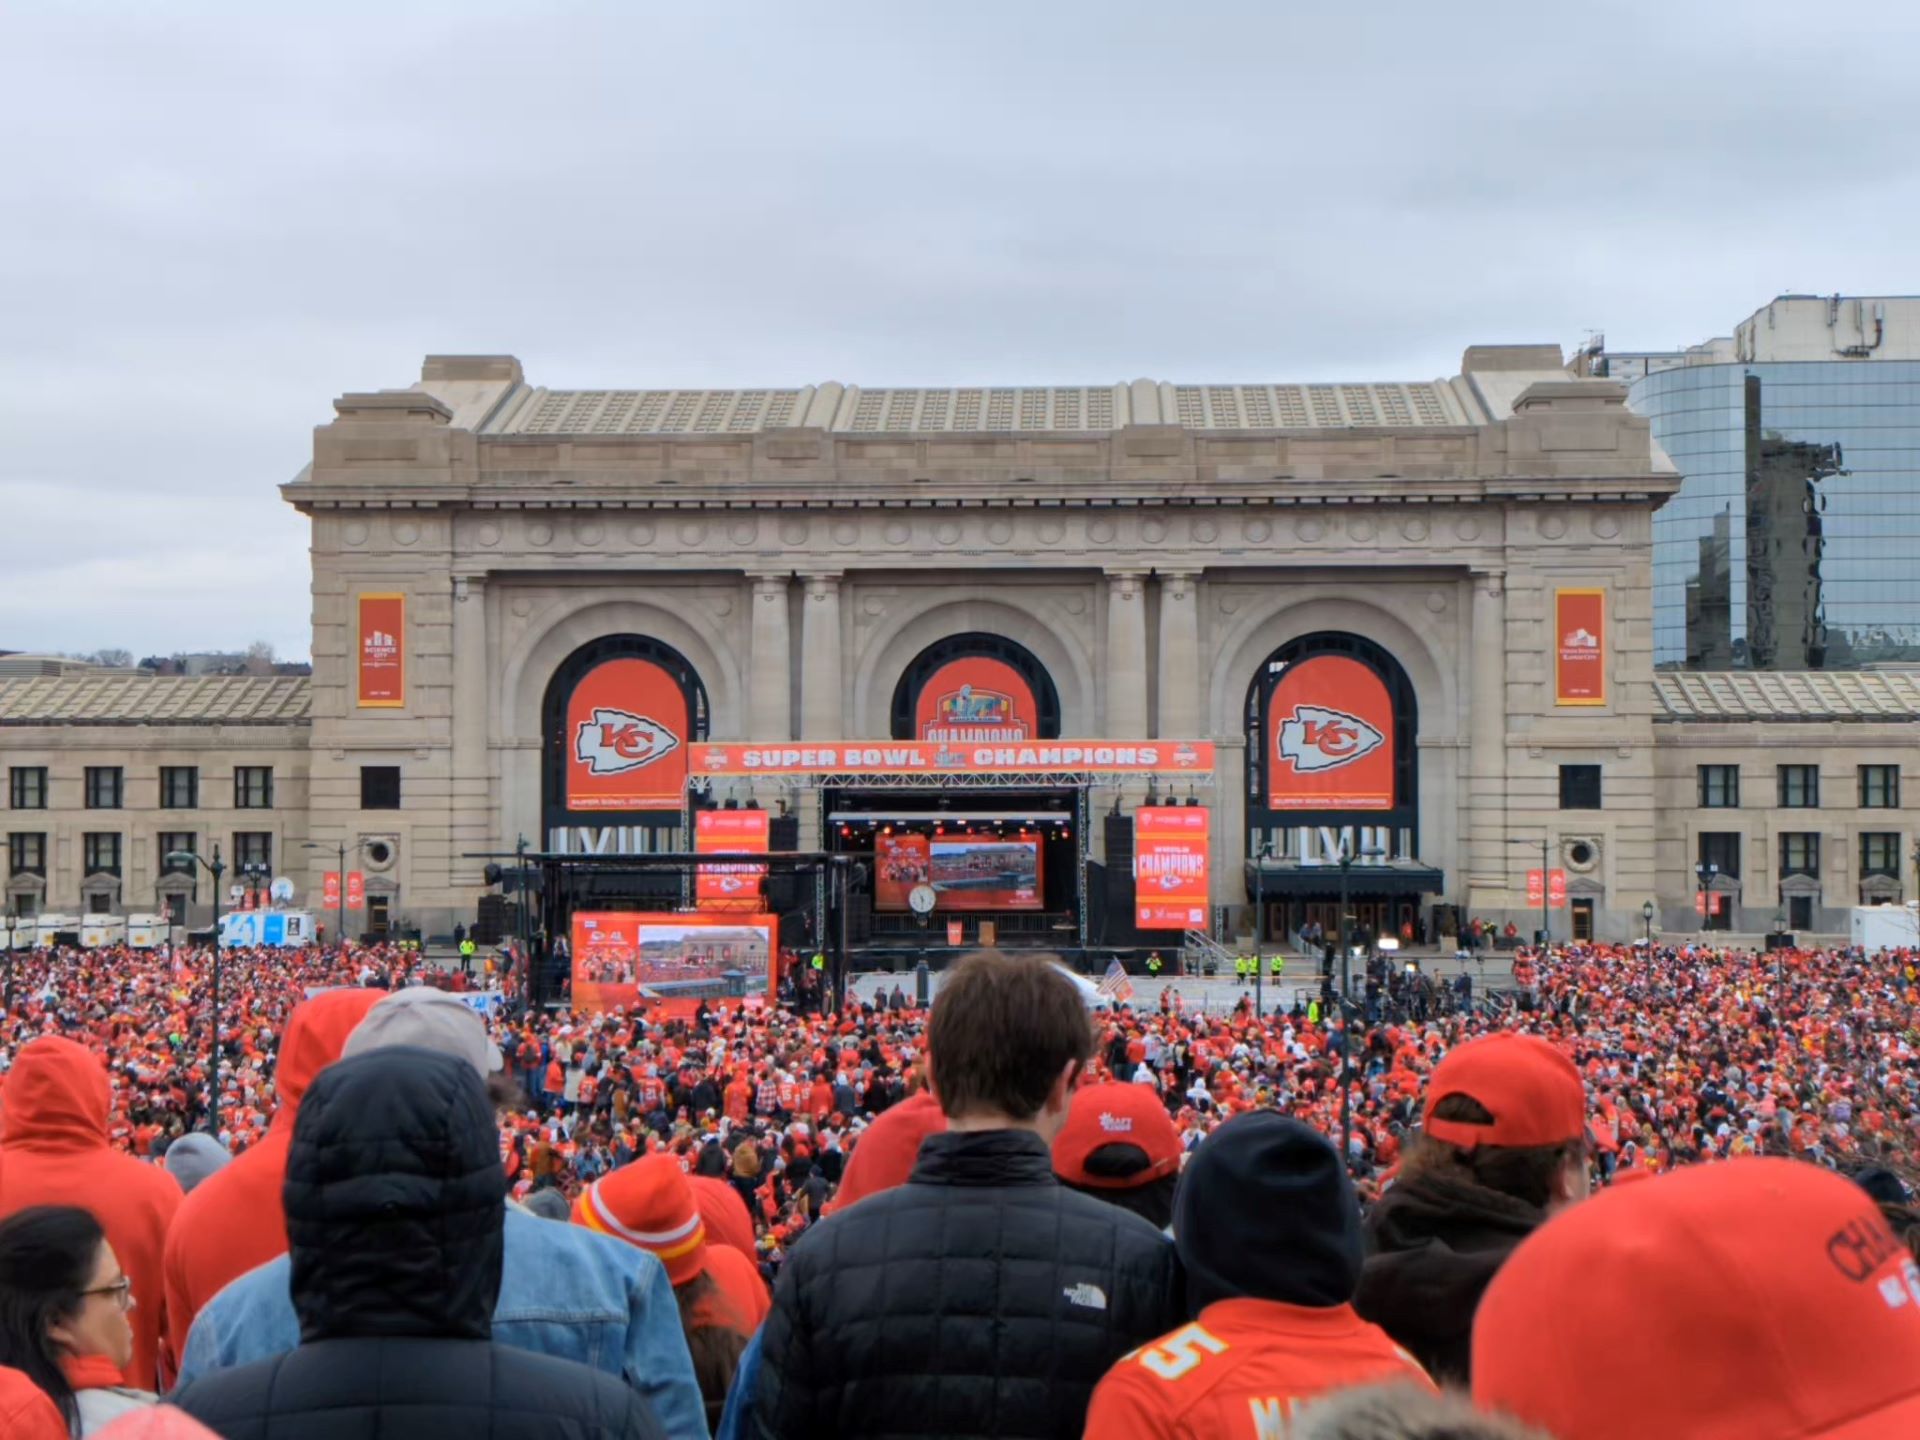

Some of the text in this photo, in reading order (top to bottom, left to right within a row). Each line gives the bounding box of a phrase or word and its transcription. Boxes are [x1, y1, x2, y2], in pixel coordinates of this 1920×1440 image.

[599, 723, 655, 759] KC
[1302, 720, 1358, 756] KC
[743, 750, 836, 767] SUPER
[844, 749, 925, 766] BOWL
[974, 748, 1158, 765] CHAMPIONS
[1139, 854, 1204, 878] CHAMPIONS
[1119, 1321, 1230, 1381] 5
